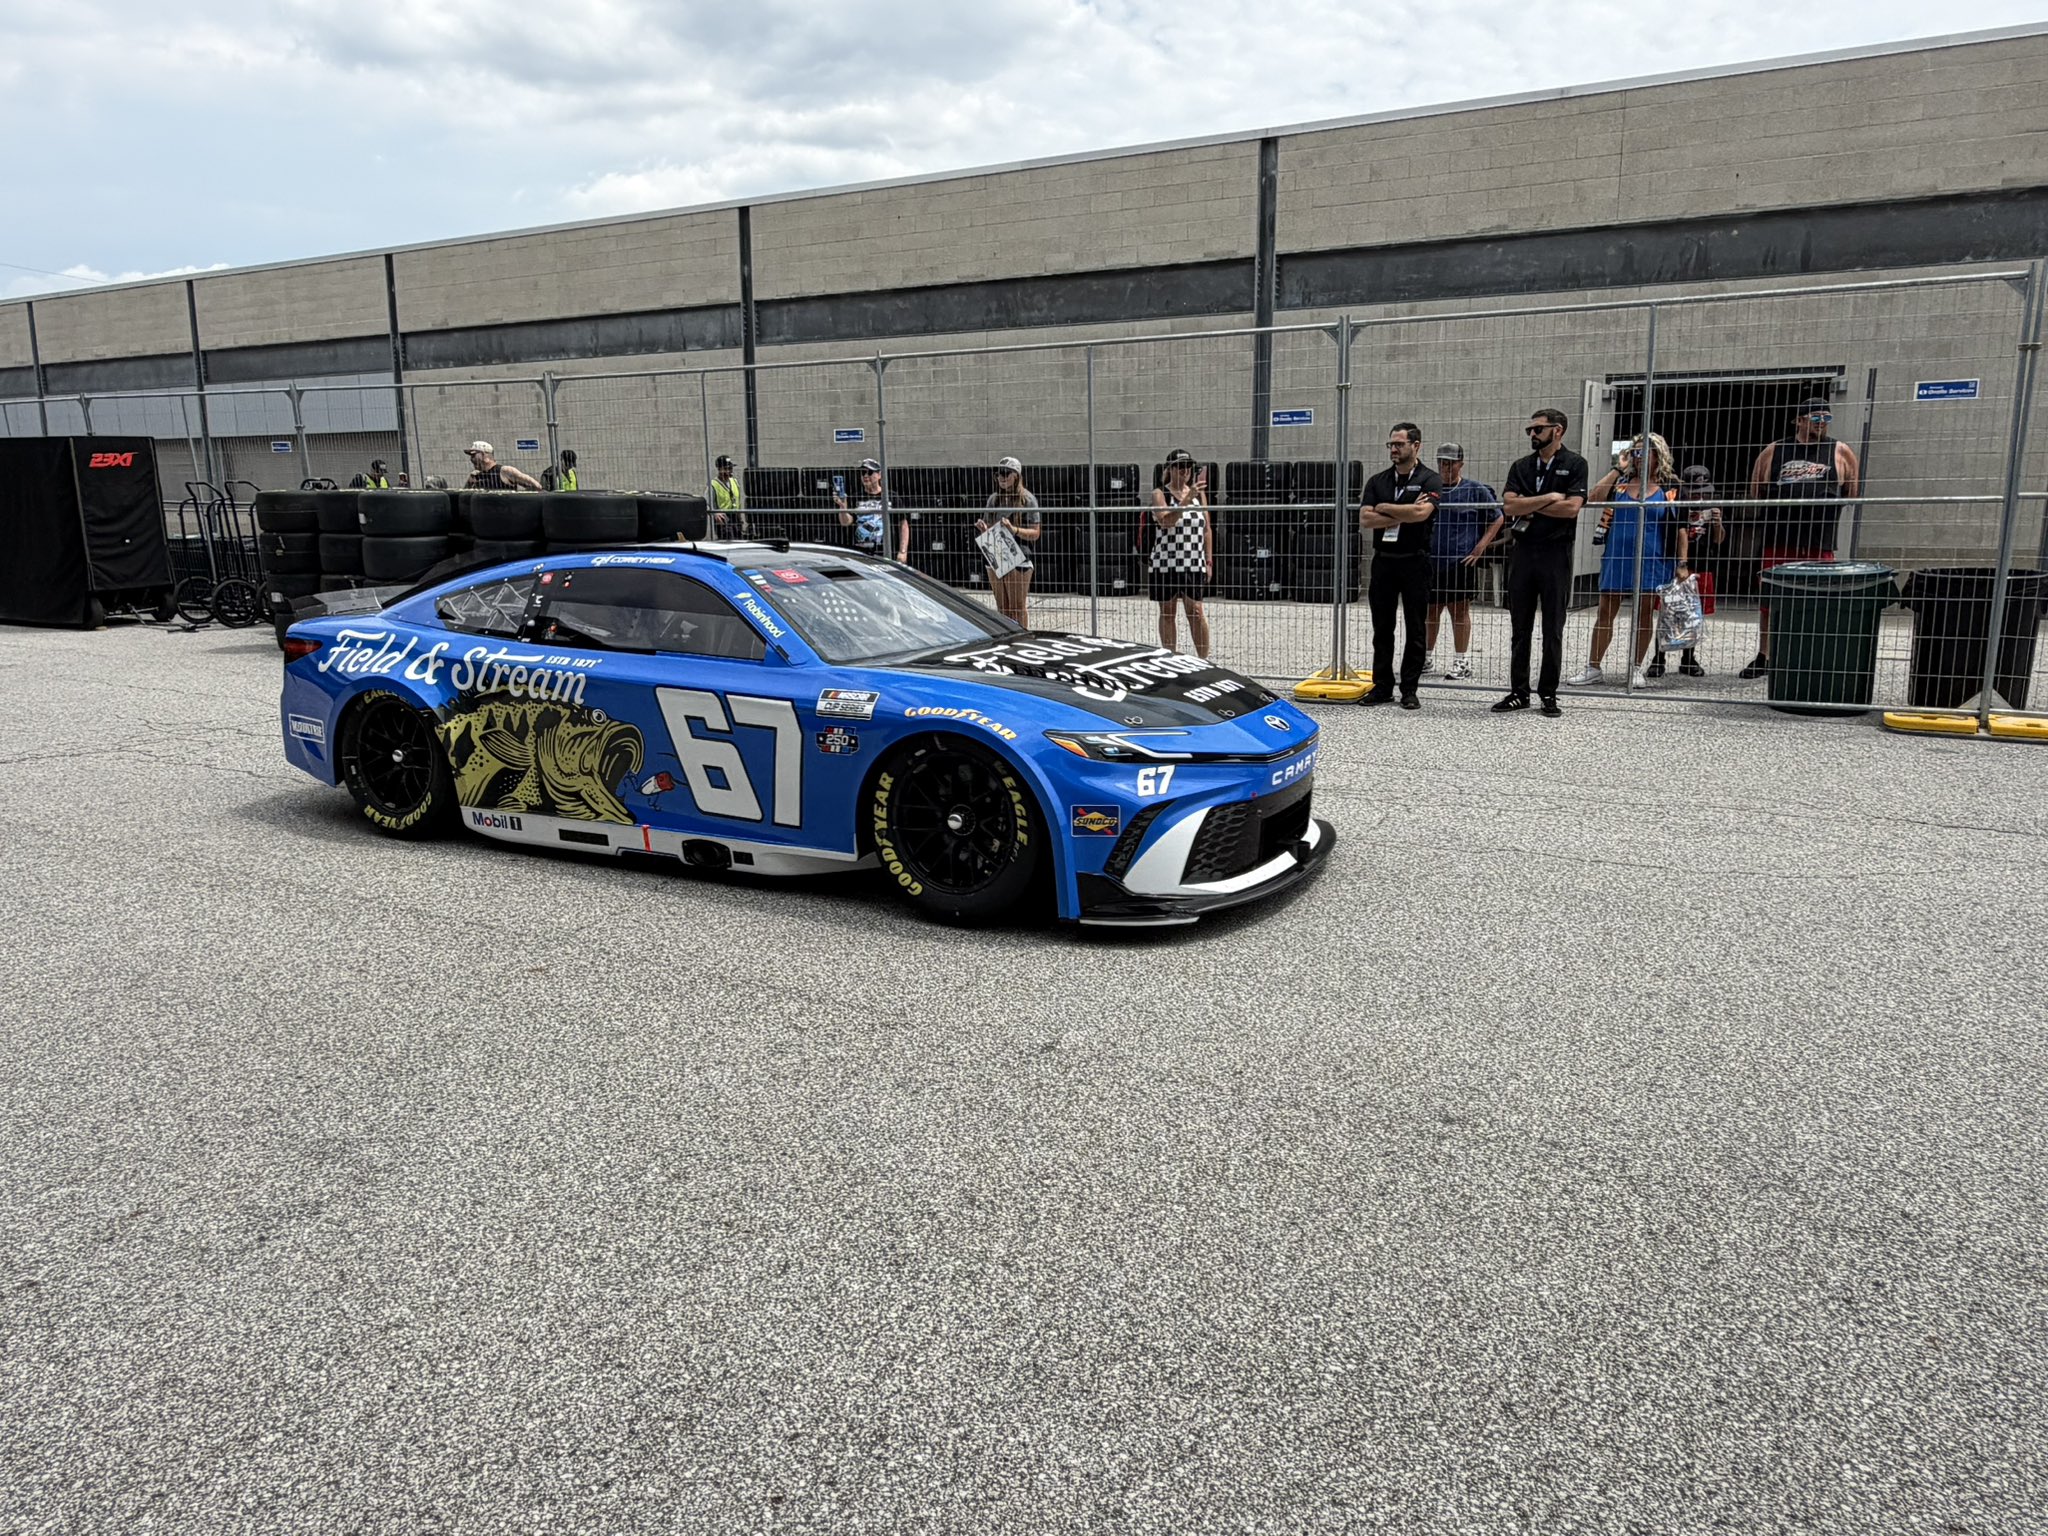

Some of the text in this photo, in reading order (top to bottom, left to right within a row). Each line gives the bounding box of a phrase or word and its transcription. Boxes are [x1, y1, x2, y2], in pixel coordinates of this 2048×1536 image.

[89, 452, 138, 468] 23XI
[743, 598, 786, 638] Robinhood
[318, 629, 586, 705] Field & Stream
[943, 638, 1102, 676] Field
[826, 734, 849, 746] 250
[904, 706, 1018, 741] GOODYEAR
[655, 685, 802, 829] 67
[1137, 764, 1175, 797] 67
[363, 791, 432, 830] GOODYEAR
[472, 811, 523, 831] Mobil 1
[1002, 776, 1028, 846] EAGLE
[1074, 816, 1118, 828] SUNOCO
[873, 772, 924, 896] GOODYEAR
